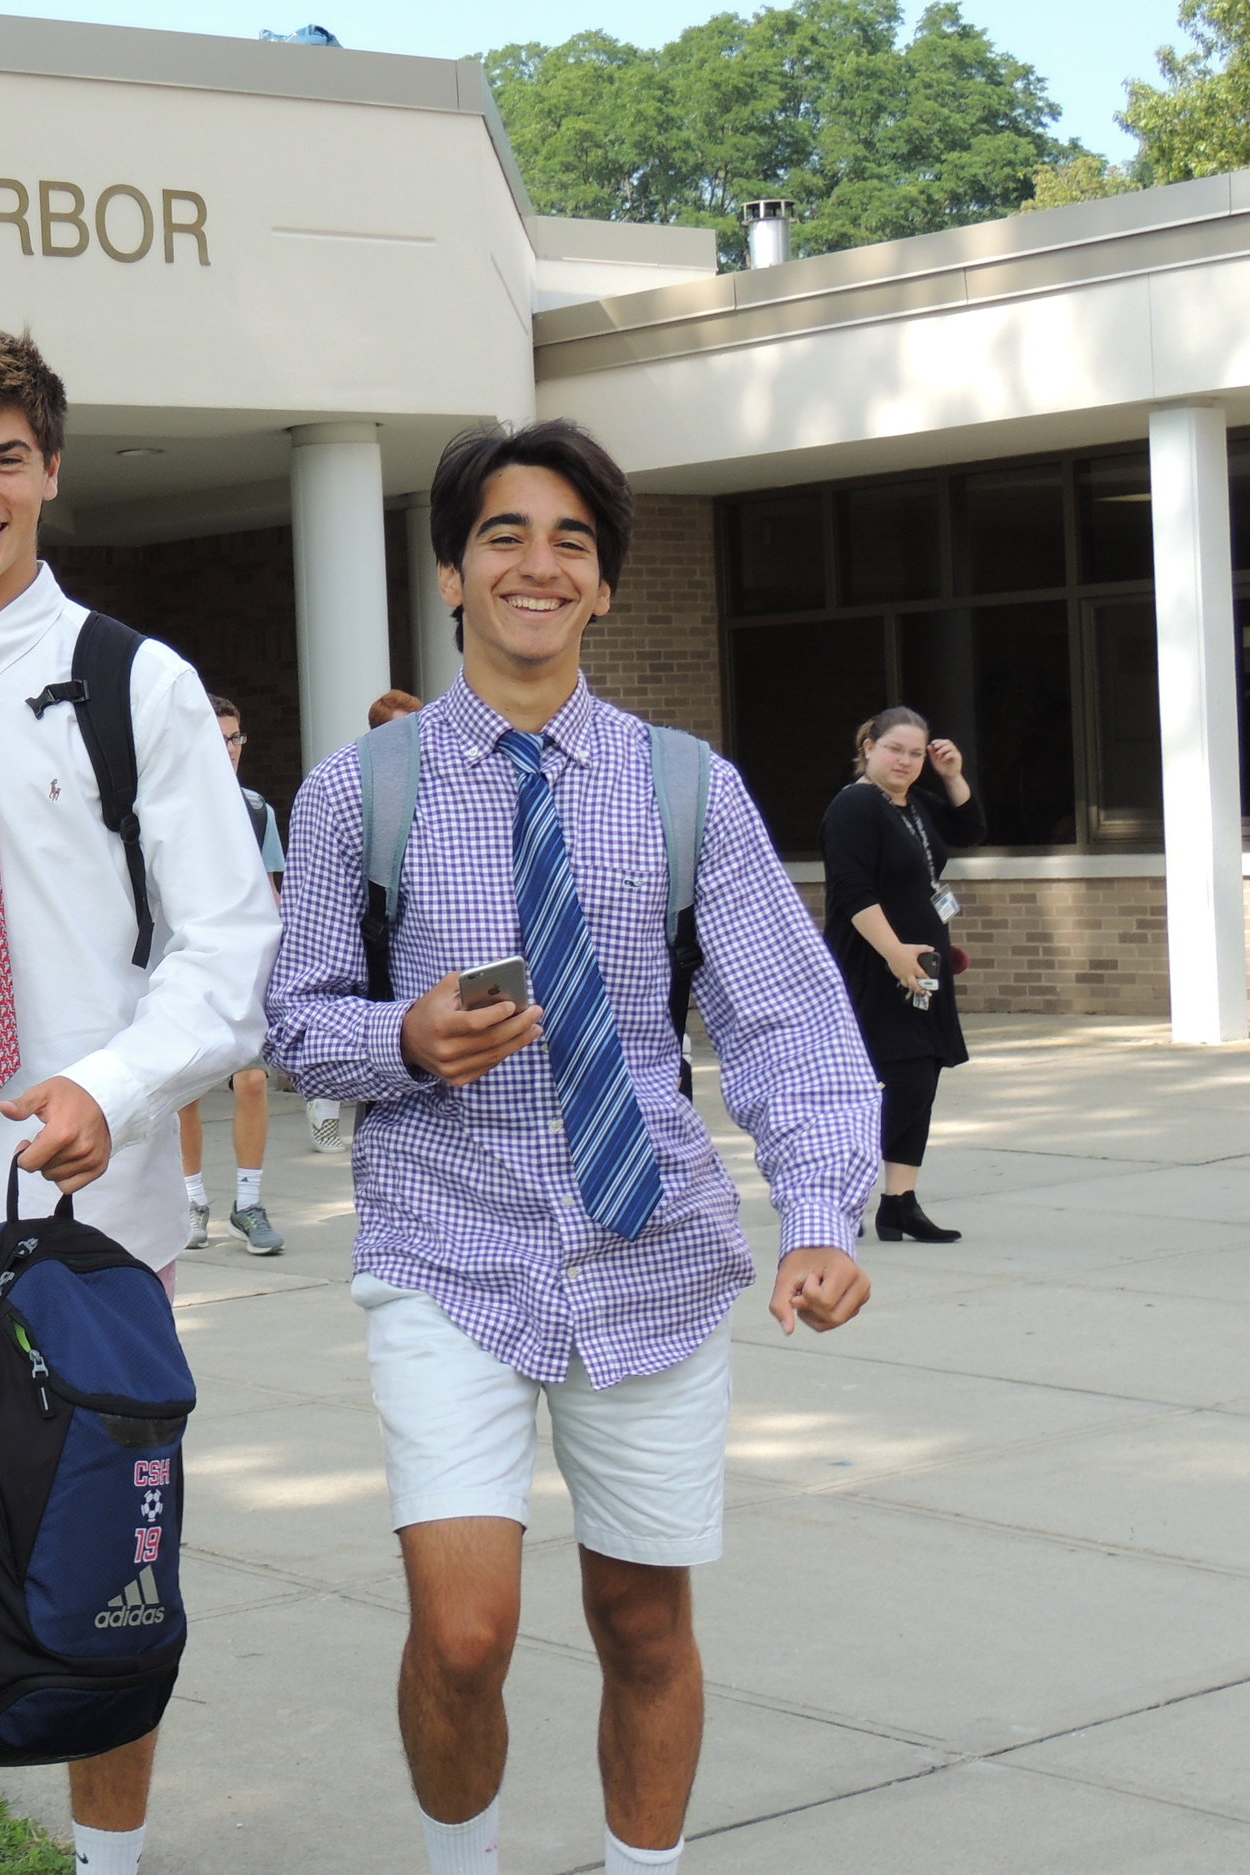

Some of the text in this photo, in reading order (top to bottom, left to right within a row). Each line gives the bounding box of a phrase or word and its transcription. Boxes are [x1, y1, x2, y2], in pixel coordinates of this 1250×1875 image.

[133, 1458, 171, 1487] CSH
[134, 1526, 162, 1563] 19
[94, 1603, 165, 1629] adidas
